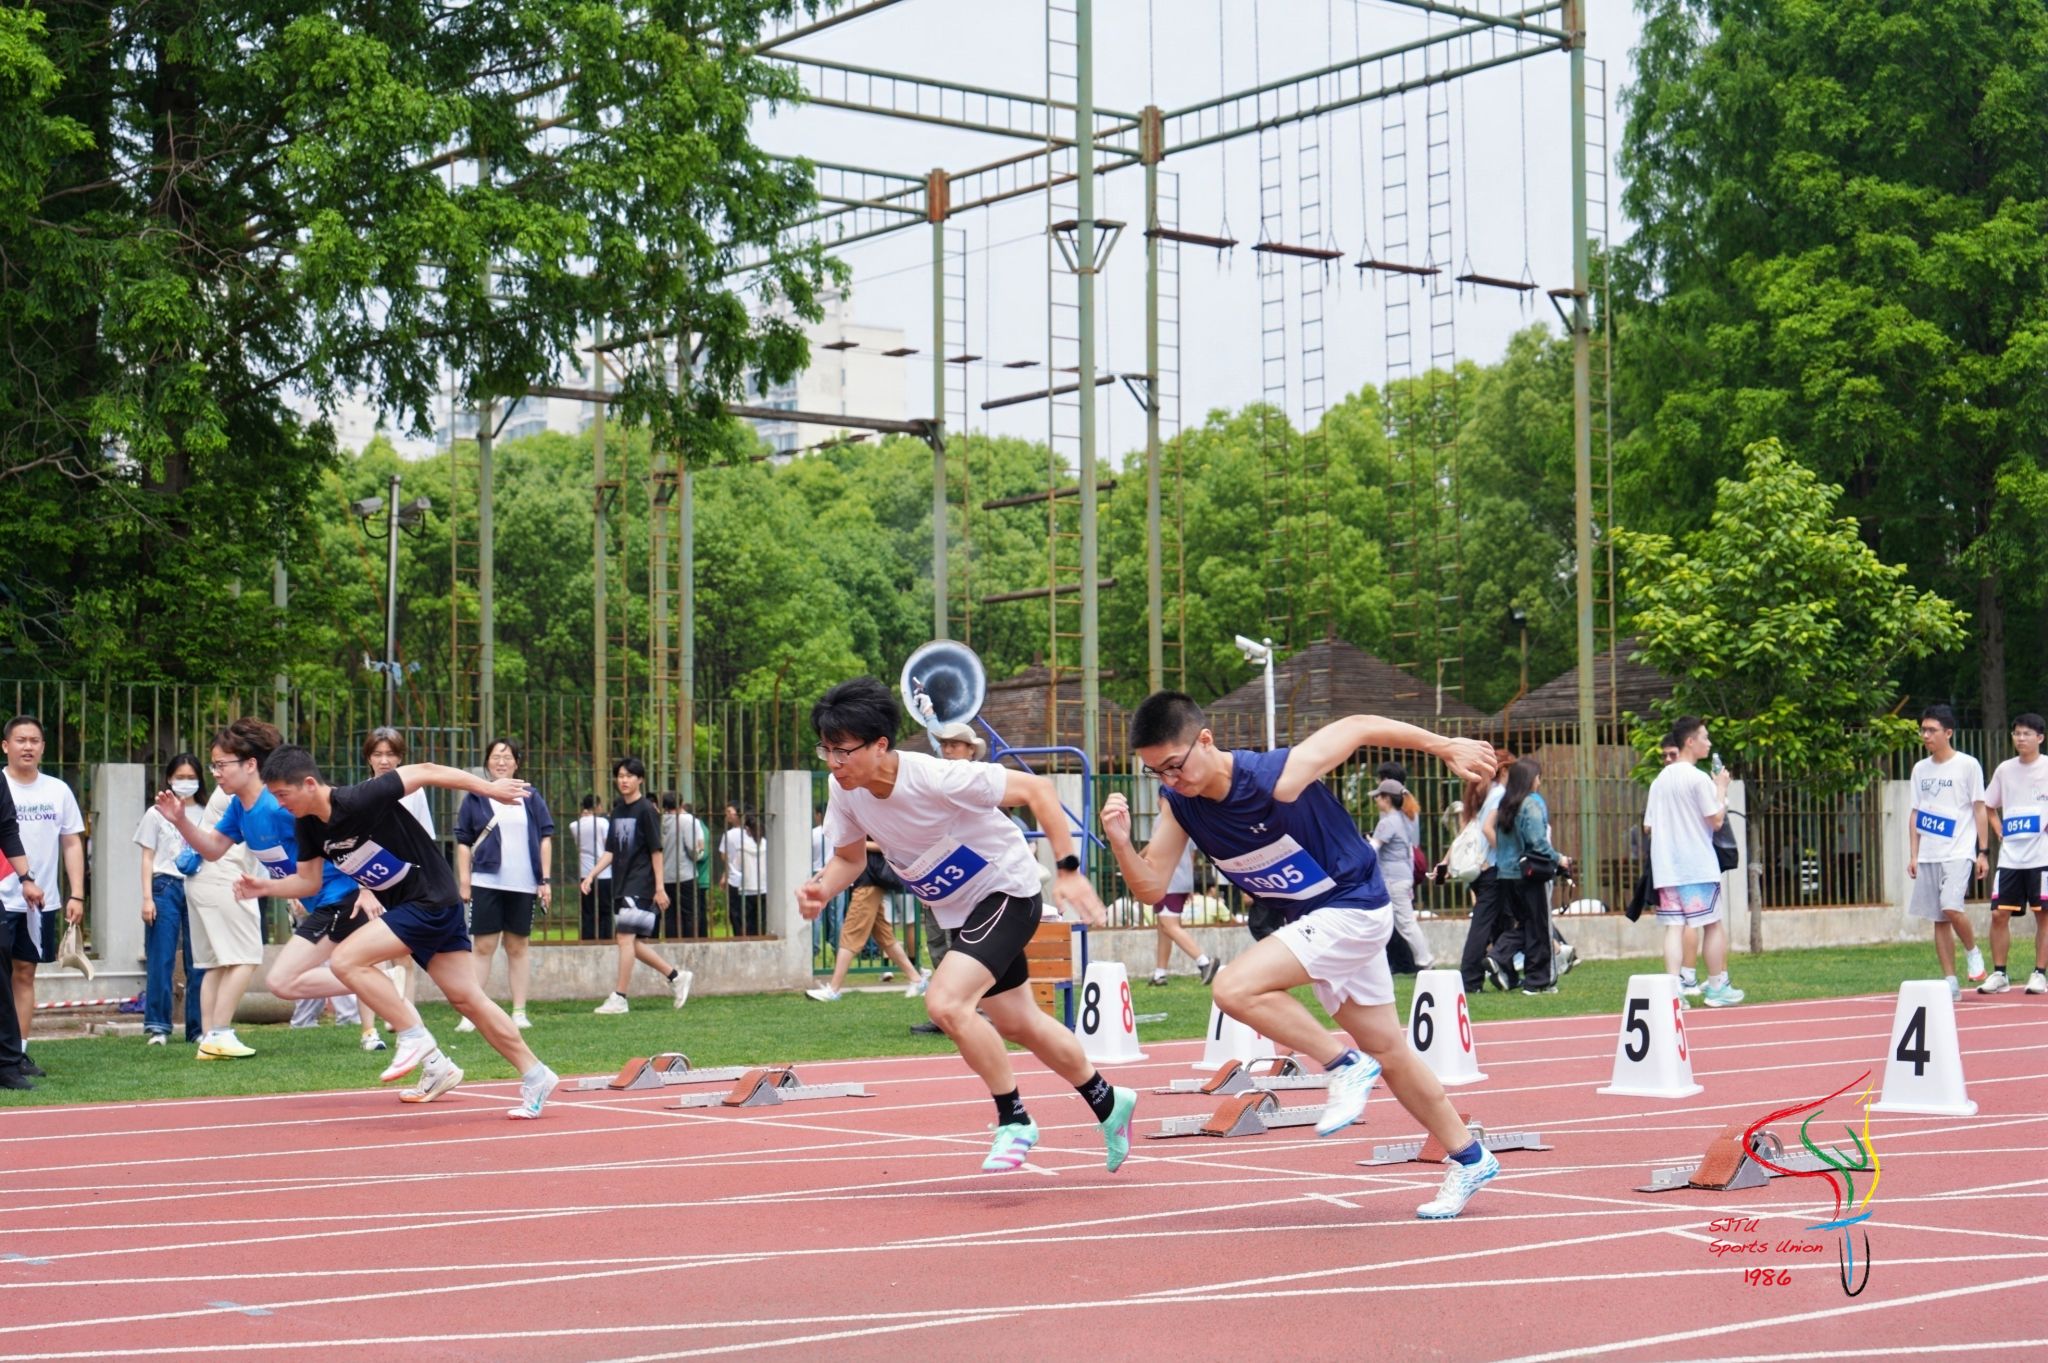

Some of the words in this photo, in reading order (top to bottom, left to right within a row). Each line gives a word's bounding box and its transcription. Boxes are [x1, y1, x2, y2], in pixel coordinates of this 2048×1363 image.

[16, 813, 57, 821] OLLOWE
[1921, 815, 1946, 833] 0214
[2007, 818, 2031, 833] 0514
[910, 865, 965, 898] 0513
[1244, 864, 1304, 890] 1905
[1082, 981, 1101, 1035] 8
[1120, 980, 1133, 1034] 8
[1412, 991, 1435, 1052] 6
[1457, 993, 1472, 1053] 6
[1624, 998, 1650, 1063] 5
[1673, 997, 1687, 1062] 5
[1896, 1006, 1931, 1077] 4
